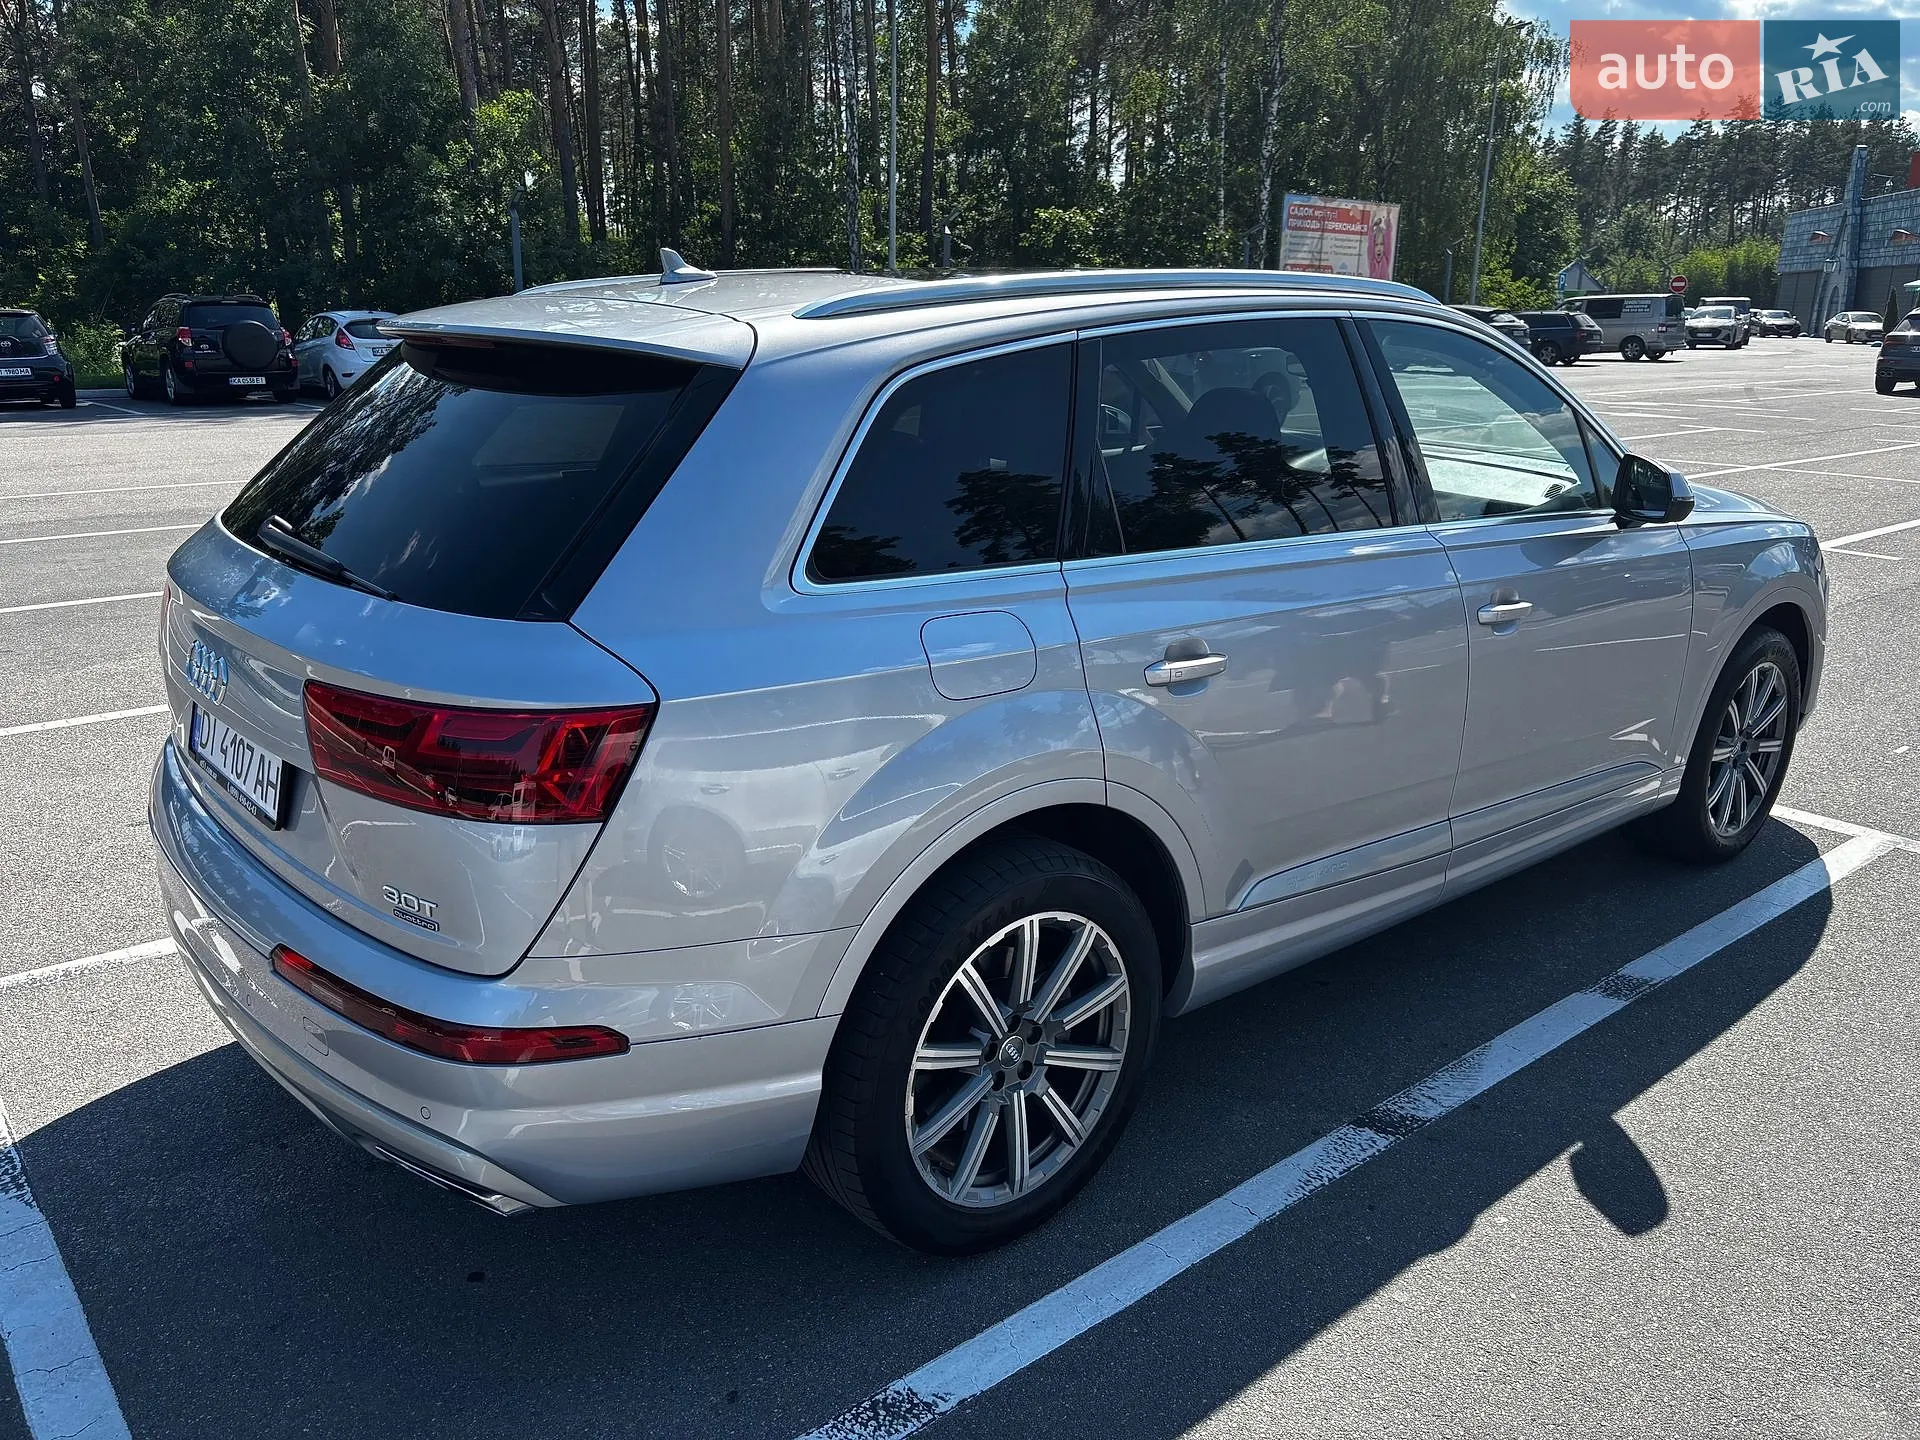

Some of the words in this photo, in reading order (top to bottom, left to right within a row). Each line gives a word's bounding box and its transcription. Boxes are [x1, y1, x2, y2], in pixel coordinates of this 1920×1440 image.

[200, 711, 217, 756] DI
[220, 727, 255, 786] 4107
[254, 753, 280, 810] AH
[394, 910, 435, 930] quattro
